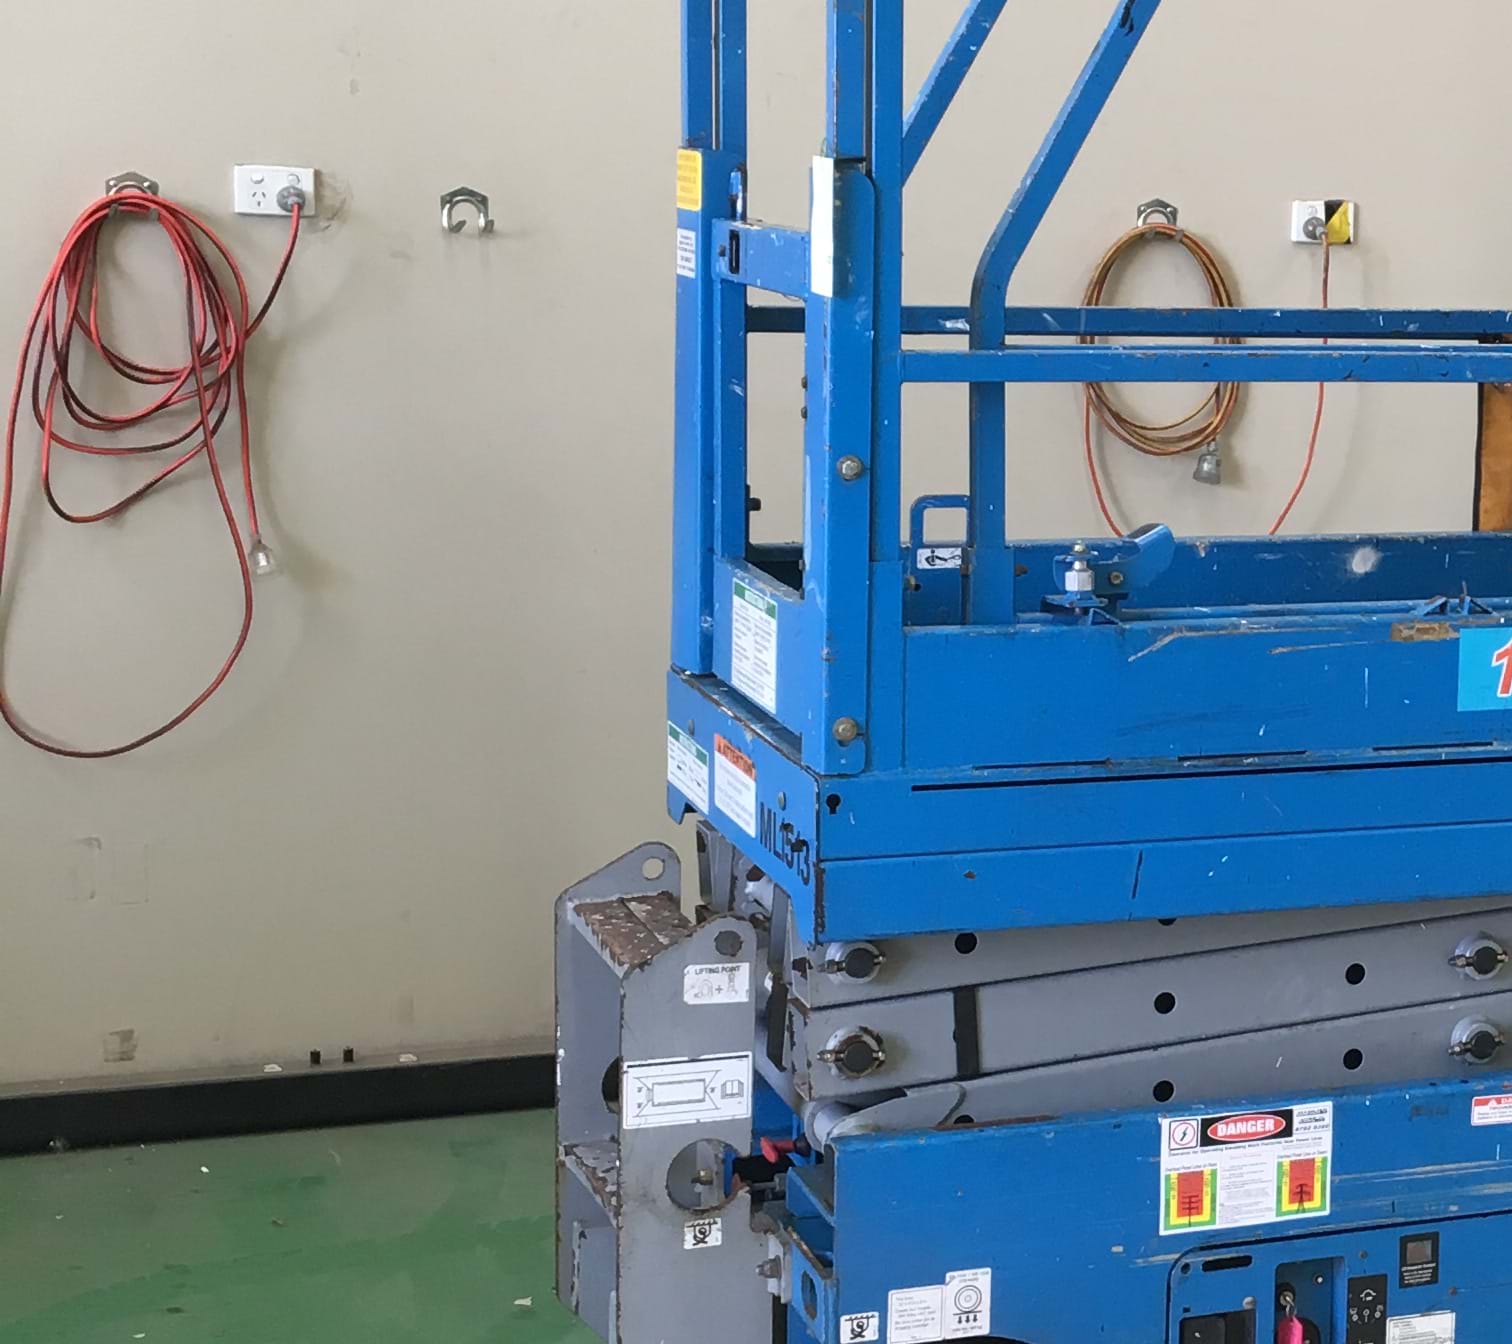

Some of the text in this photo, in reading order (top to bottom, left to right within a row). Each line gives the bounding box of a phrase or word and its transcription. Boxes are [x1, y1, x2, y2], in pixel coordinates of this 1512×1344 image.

[694, 964, 741, 975] LIFTING POINT
[1217, 1118, 1275, 1137] DANGER
